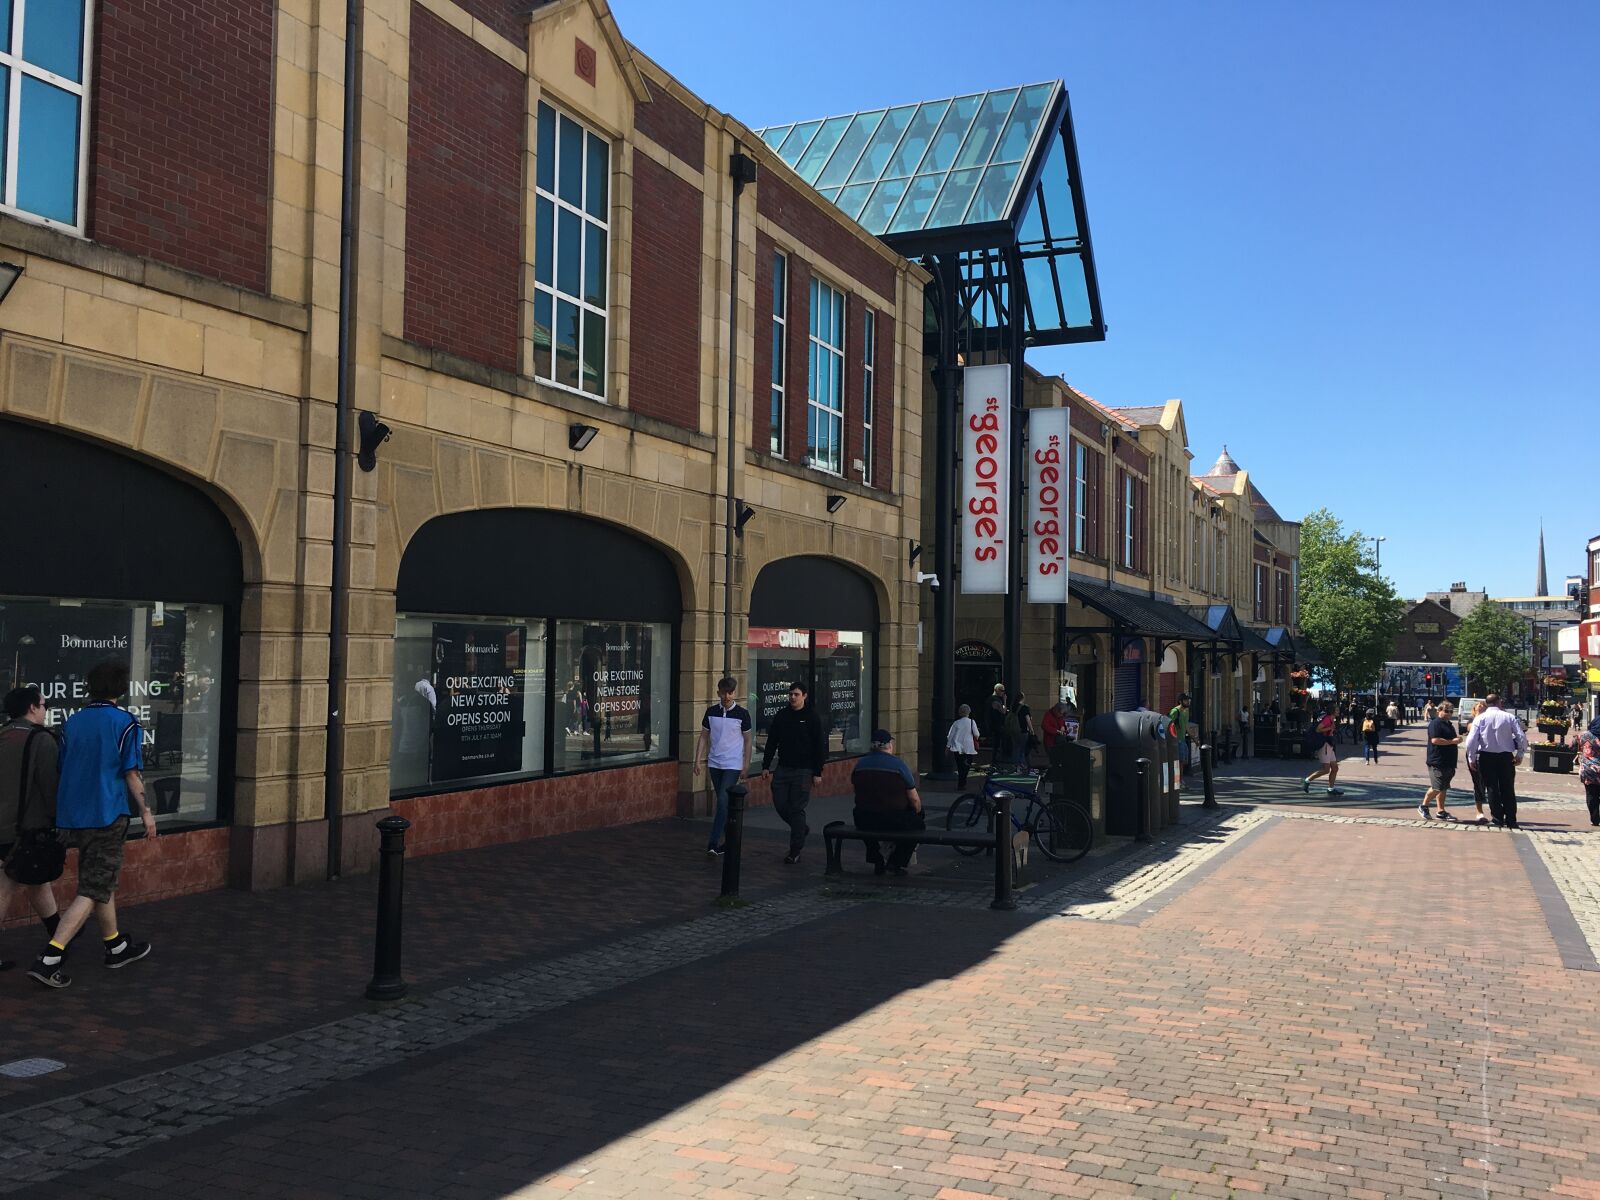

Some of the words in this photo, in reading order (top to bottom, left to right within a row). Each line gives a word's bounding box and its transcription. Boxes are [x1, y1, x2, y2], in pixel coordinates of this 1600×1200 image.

[986, 397, 999, 412] st
[1048, 435, 1060, 447] st
[968, 414, 1004, 562] george's
[1033, 448, 1064, 576] george's
[61, 634, 128, 649] Bonmarché
[465, 643, 500, 654] Bonmarché
[445, 677, 469, 689] OUR
[471, 676, 514, 688] EXCITING
[593, 671, 609, 682] OUR
[610, 670, 644, 681] EXCITING
[73, 680, 162, 698] EING
[596, 686, 615, 697] NEW
[616, 685, 640, 696] STORE
[762, 682, 775, 692] OUR
[451, 694, 476, 707] NEW
[477, 693, 509, 706] STORE
[765, 694, 777, 704] NEW
[593, 701, 620, 713] OPENS
[621, 700, 641, 711] SOON
[447, 712, 481, 726] OPENS
[483, 711, 511, 724] SOON
[462, 725, 478, 733] OPENS
